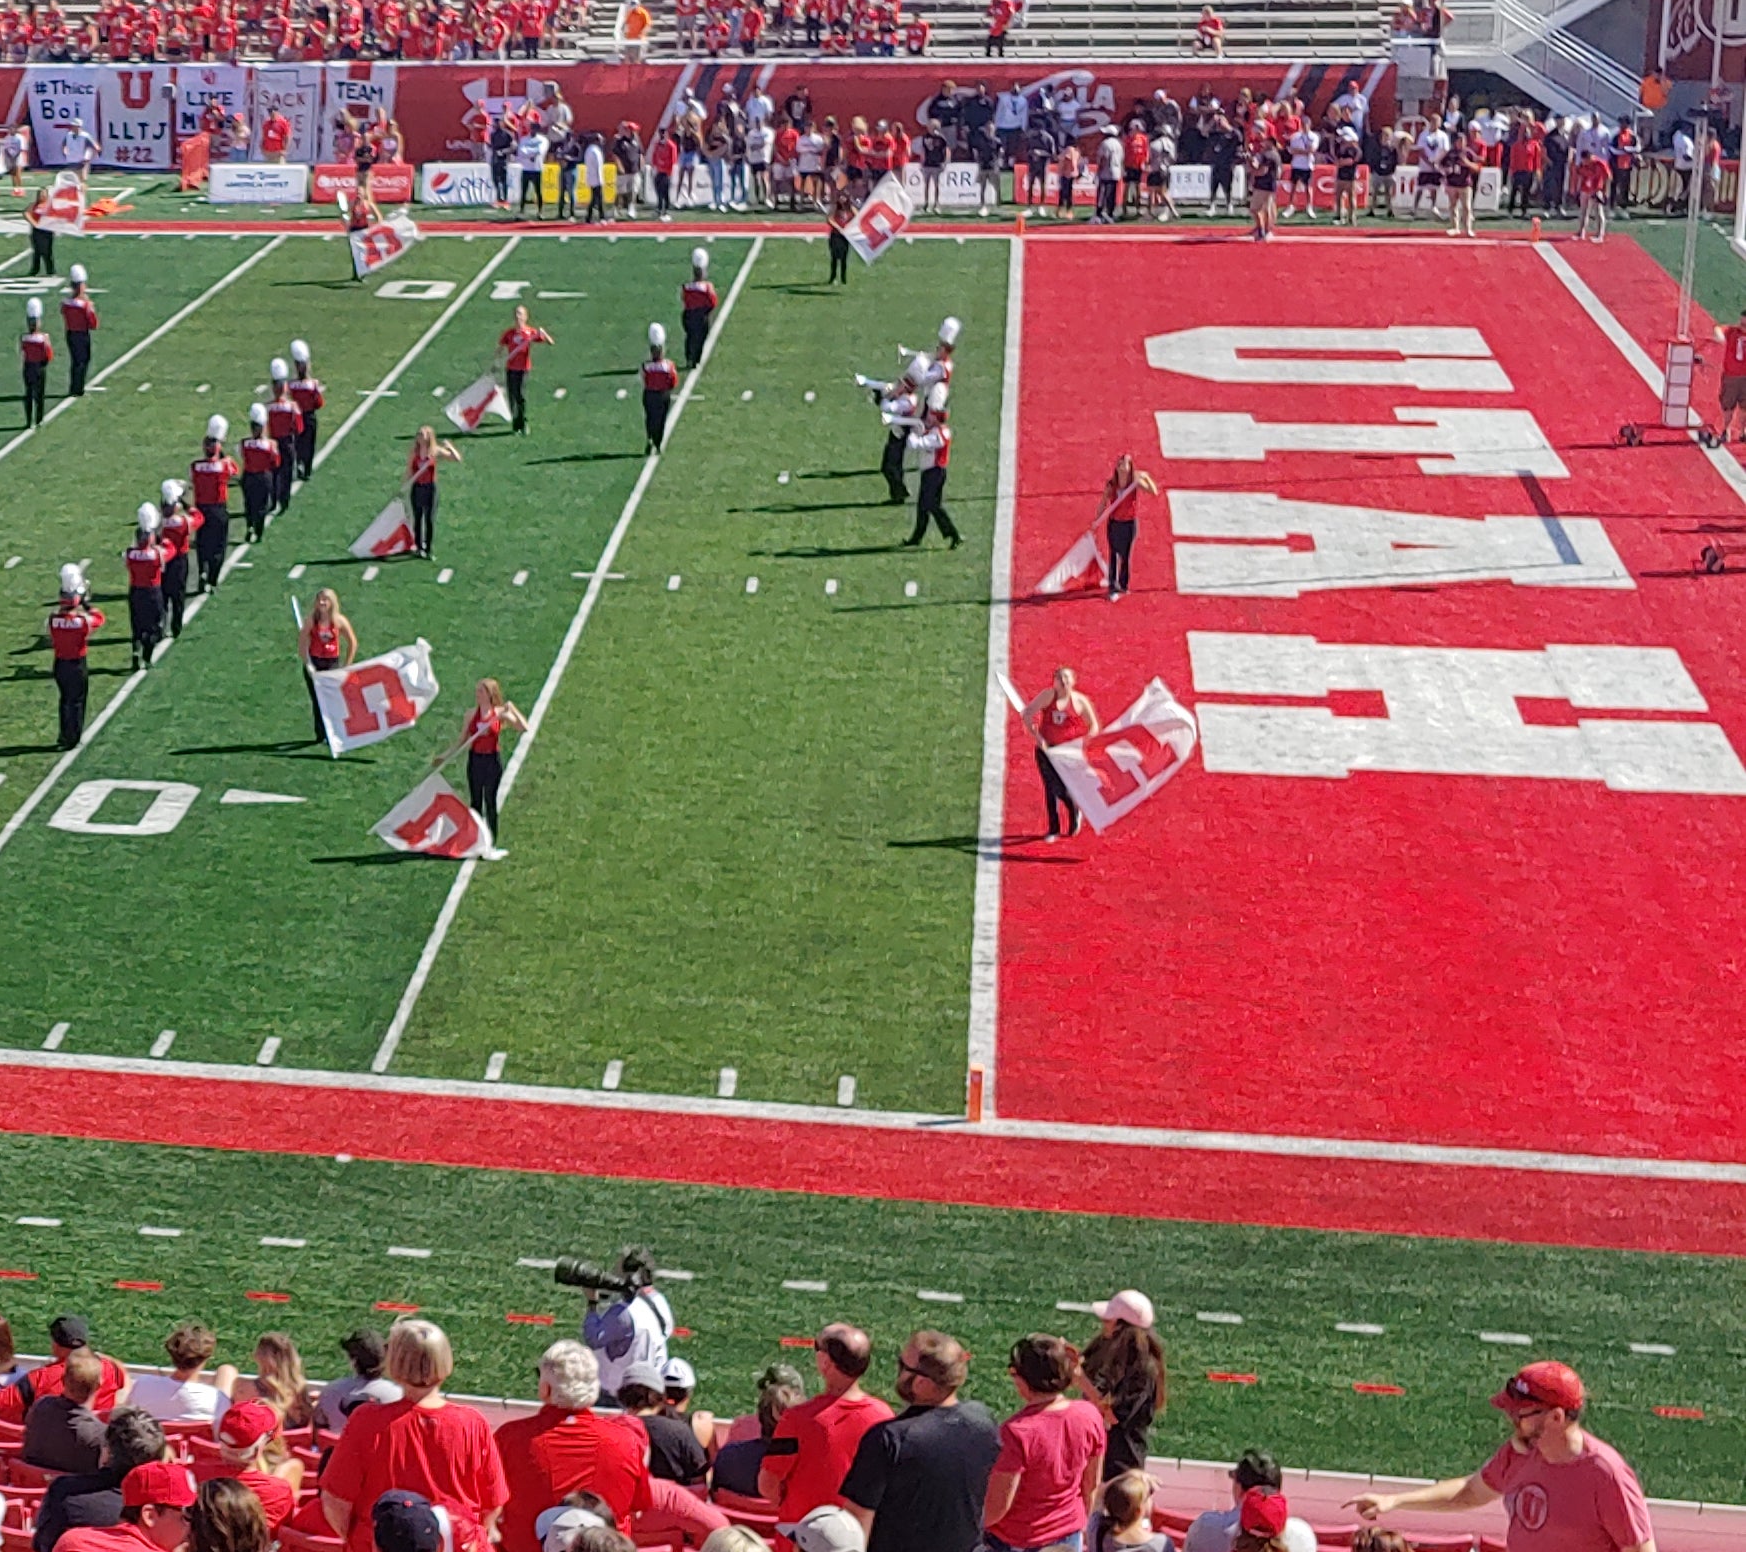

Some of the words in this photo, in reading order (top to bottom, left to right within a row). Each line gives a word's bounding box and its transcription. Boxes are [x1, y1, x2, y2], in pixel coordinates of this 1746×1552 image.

[33, 79, 95, 96] #Thicc
[116, 71, 152, 109] U
[335, 81, 384, 102] TEAM
[260, 90, 306, 107] SACK
[40, 100, 81, 120] Boi
[109, 121, 167, 141] LLTJ
[115, 146, 153, 163] #22
[1144, 325, 1746, 795] UTAH
